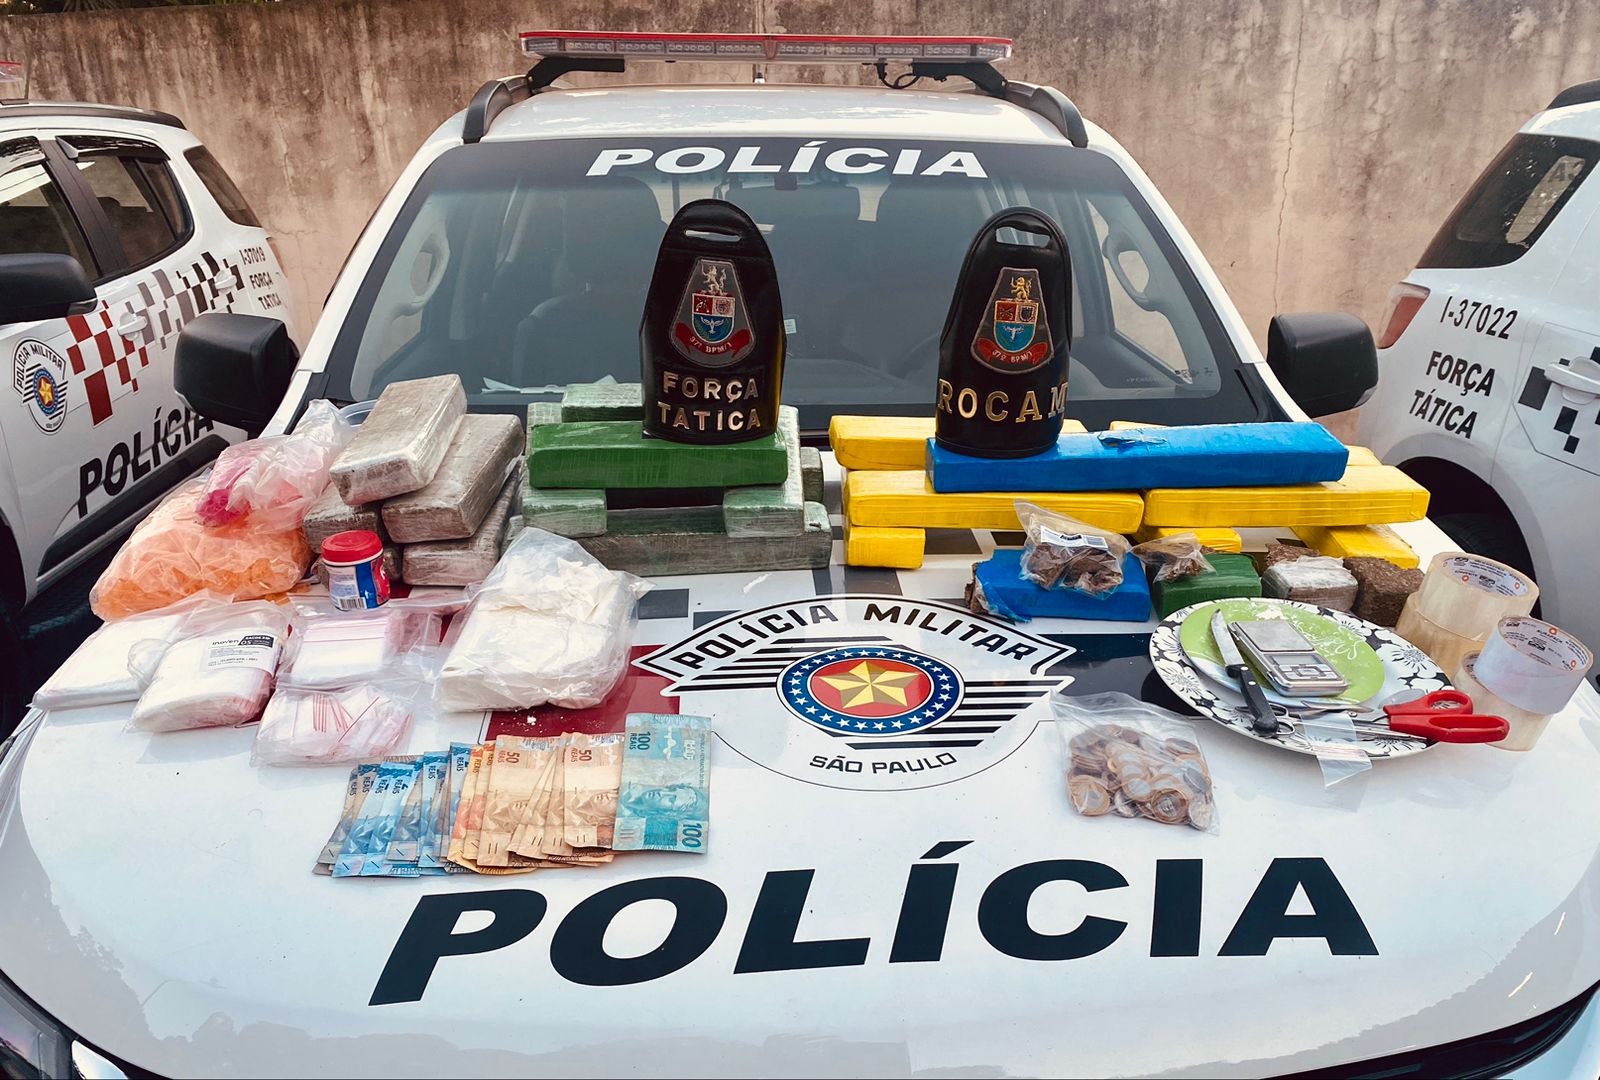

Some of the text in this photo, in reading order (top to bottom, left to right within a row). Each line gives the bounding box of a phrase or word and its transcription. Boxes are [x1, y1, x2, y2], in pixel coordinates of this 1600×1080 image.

[585, 140, 989, 179] POLÍCIA
[249, 272, 274, 290] FORÇA
[1440, 295, 1519, 340] I-37022
[30, 343, 63, 371] MILITAR
[1426, 350, 1496, 396] FORÇA
[662, 370, 760, 404] FORÇA
[937, 378, 1070, 424] ROCAM
[657, 400, 761, 432] TATICA
[1409, 388, 1478, 440] TÁTICA
[77, 406, 215, 519] POLÍCIA
[669, 602, 1040, 671] POLÍCIA MILITAR
[505, 751, 520, 764] 50
[578, 749, 592, 762] 50
[637, 731, 651, 751] 100
[456, 756, 465, 772] REAIS
[809, 752, 957, 775] SÃO PAULO
[681, 822, 703, 849] 100
[368, 840, 1380, 1006] POLÍCIA
